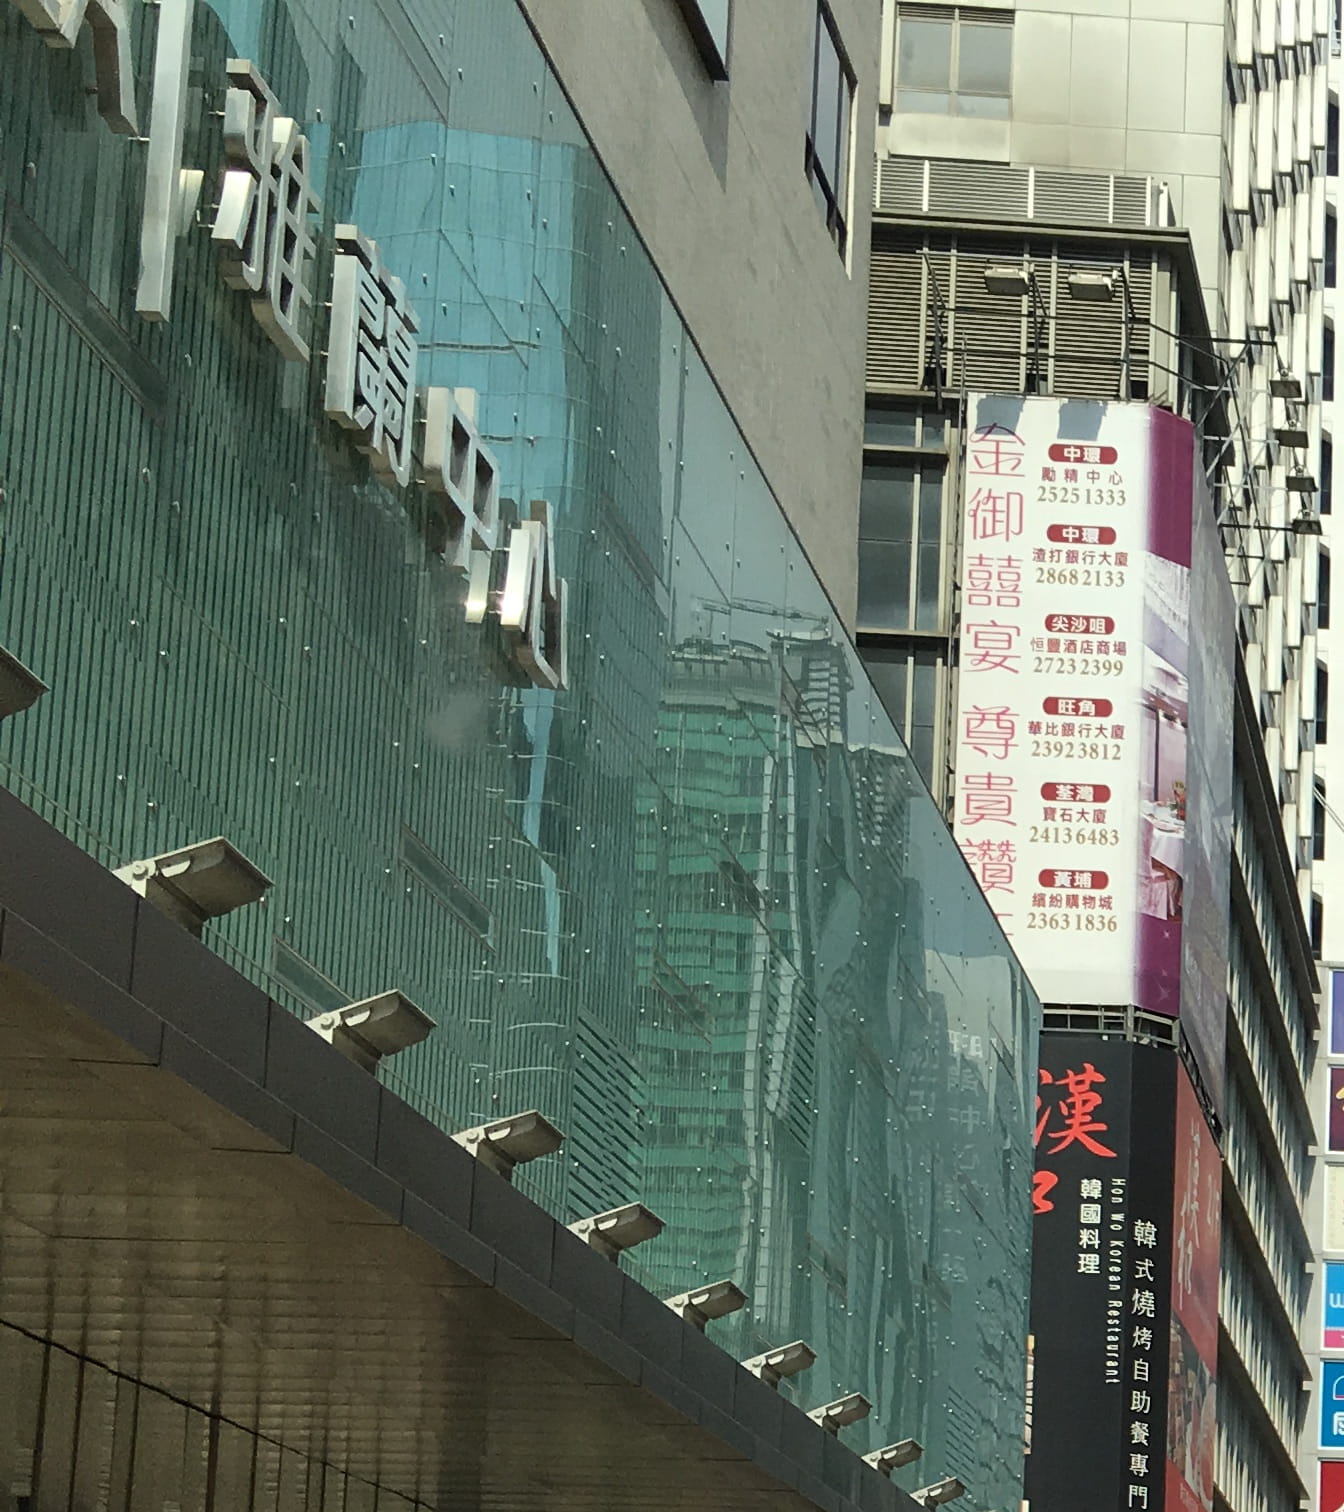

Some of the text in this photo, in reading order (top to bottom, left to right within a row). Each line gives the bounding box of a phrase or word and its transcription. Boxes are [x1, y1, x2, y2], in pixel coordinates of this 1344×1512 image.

[1064, 446, 1100, 462] 中環
[1062, 527, 1099, 543] 中環
[1053, 617, 1107, 633] 尖沙咀
[959, 423, 1026, 938] 金御囍宴 尊貴讚
[1059, 700, 1097, 716] 旺角
[1055, 786, 1094, 802] 荃灣
[1053, 871, 1092, 887] 黃埔
[1077, 1179, 1102, 1274] 韓國料理
[1105, 1178, 1126, 1384] Hon Wo Korean Restaurant
